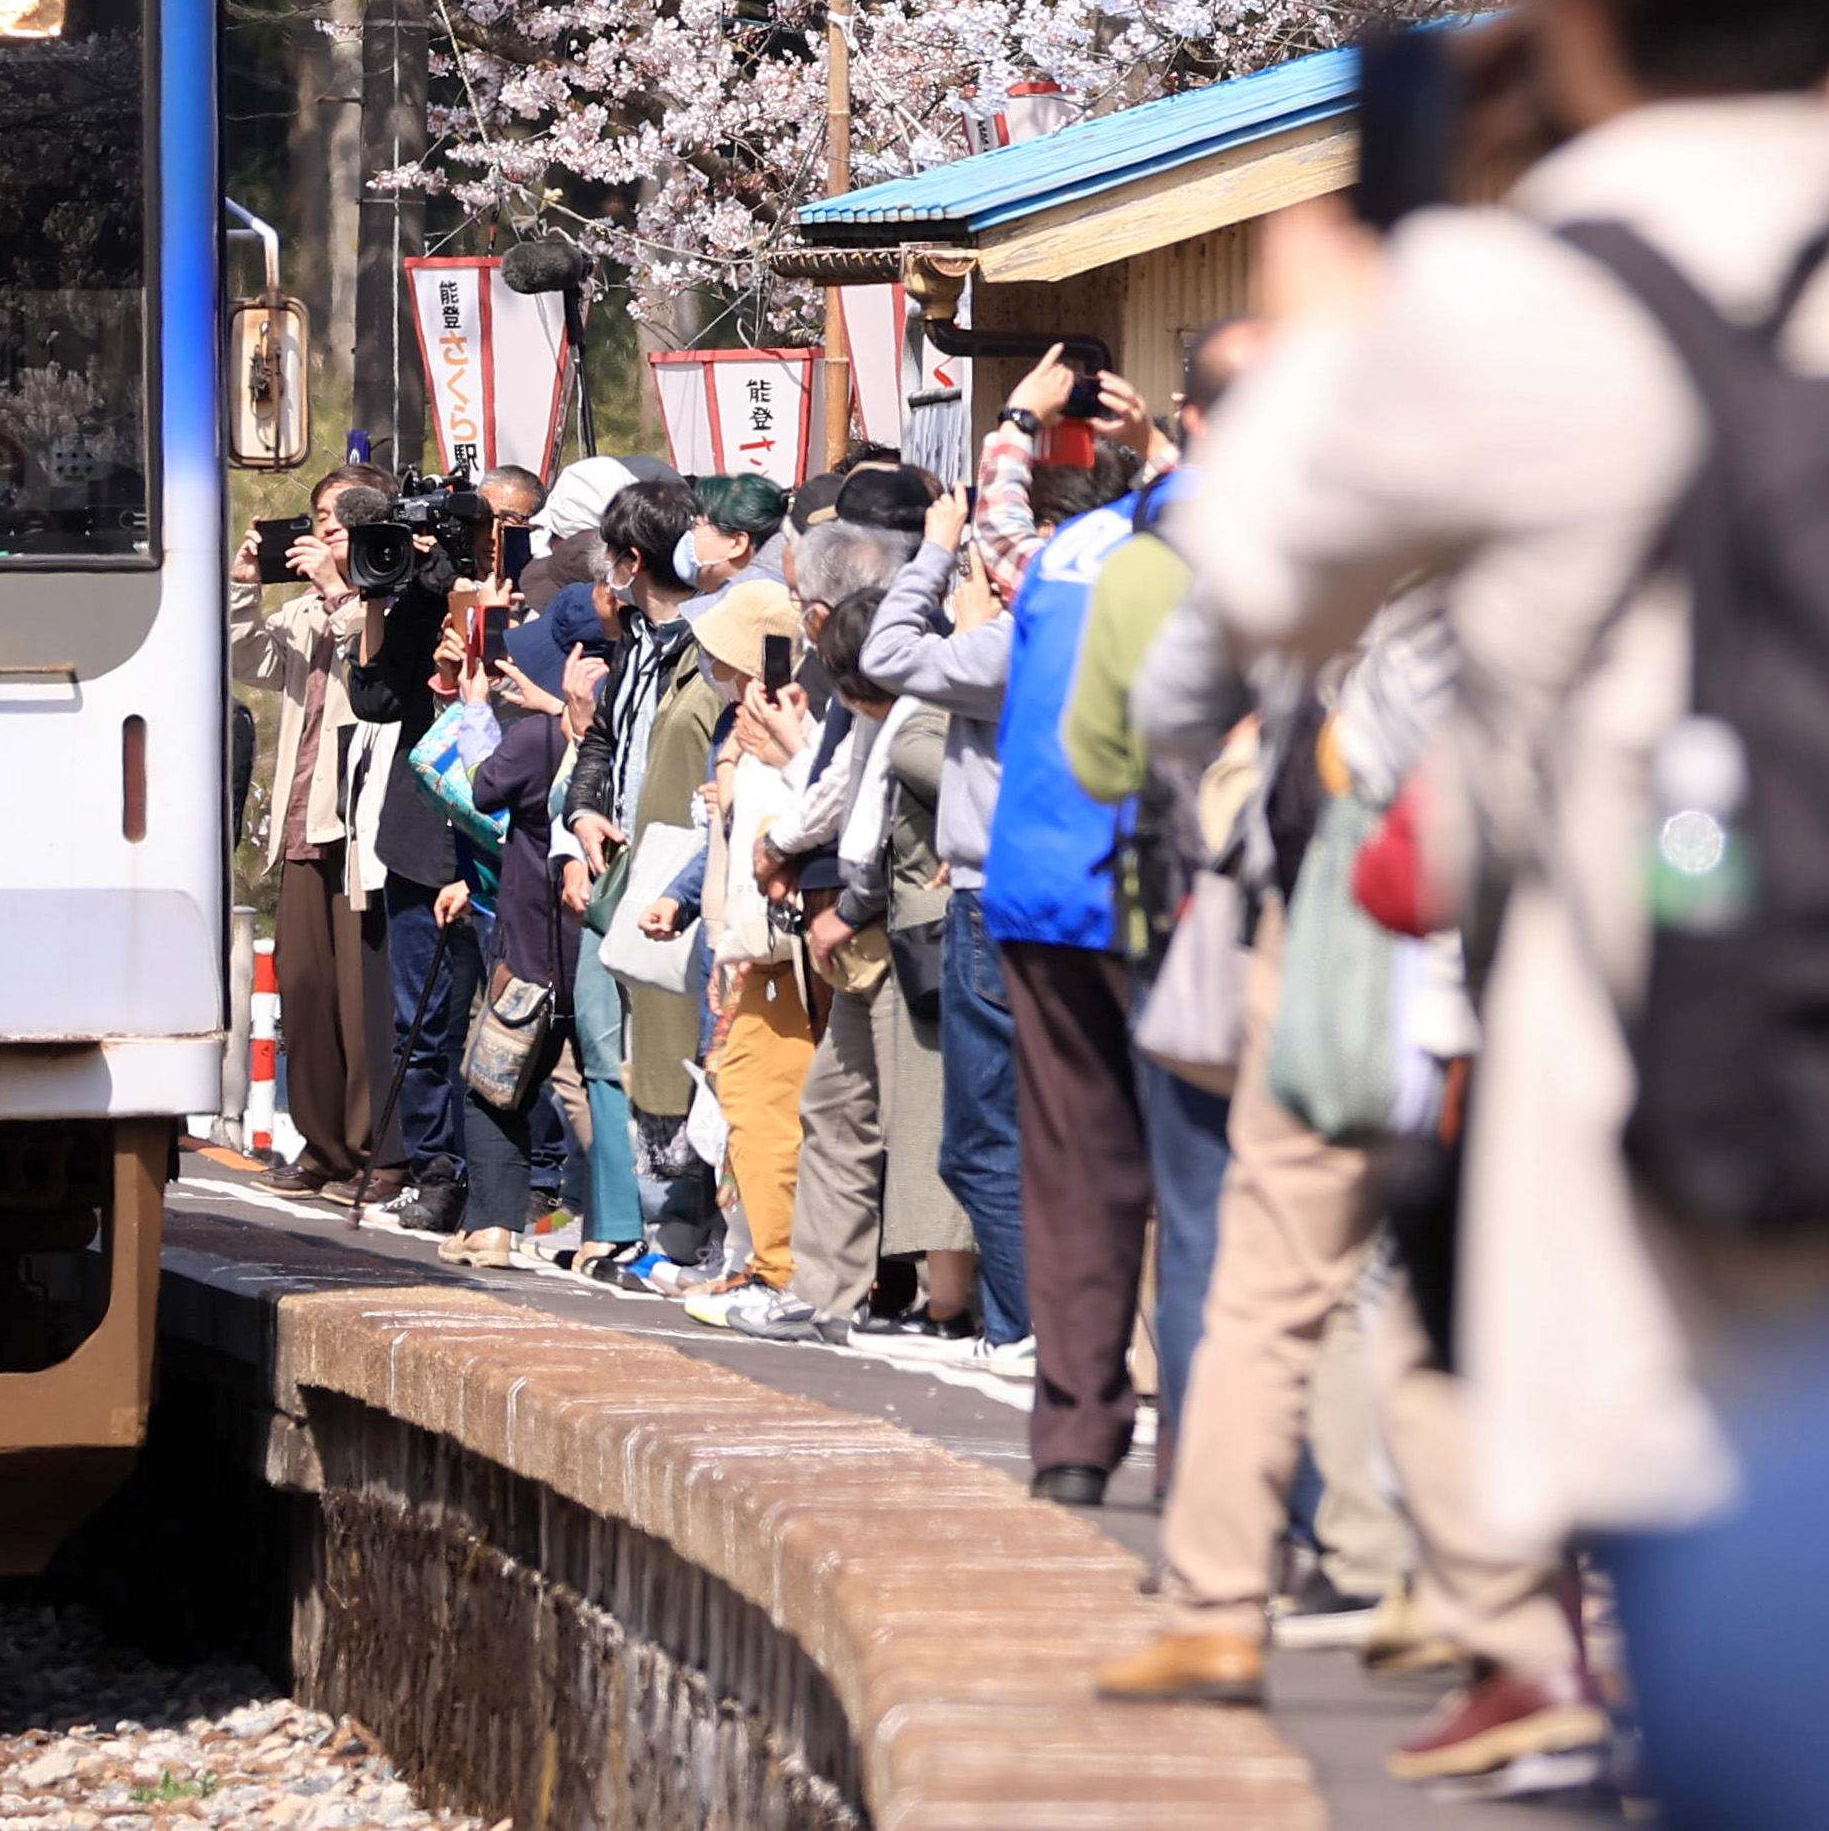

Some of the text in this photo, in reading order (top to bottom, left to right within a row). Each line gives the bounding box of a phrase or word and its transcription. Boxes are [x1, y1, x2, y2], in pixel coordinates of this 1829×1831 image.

[438, 280, 479, 471] 能登さくら駅
[739, 378, 776, 476] 能登さ
